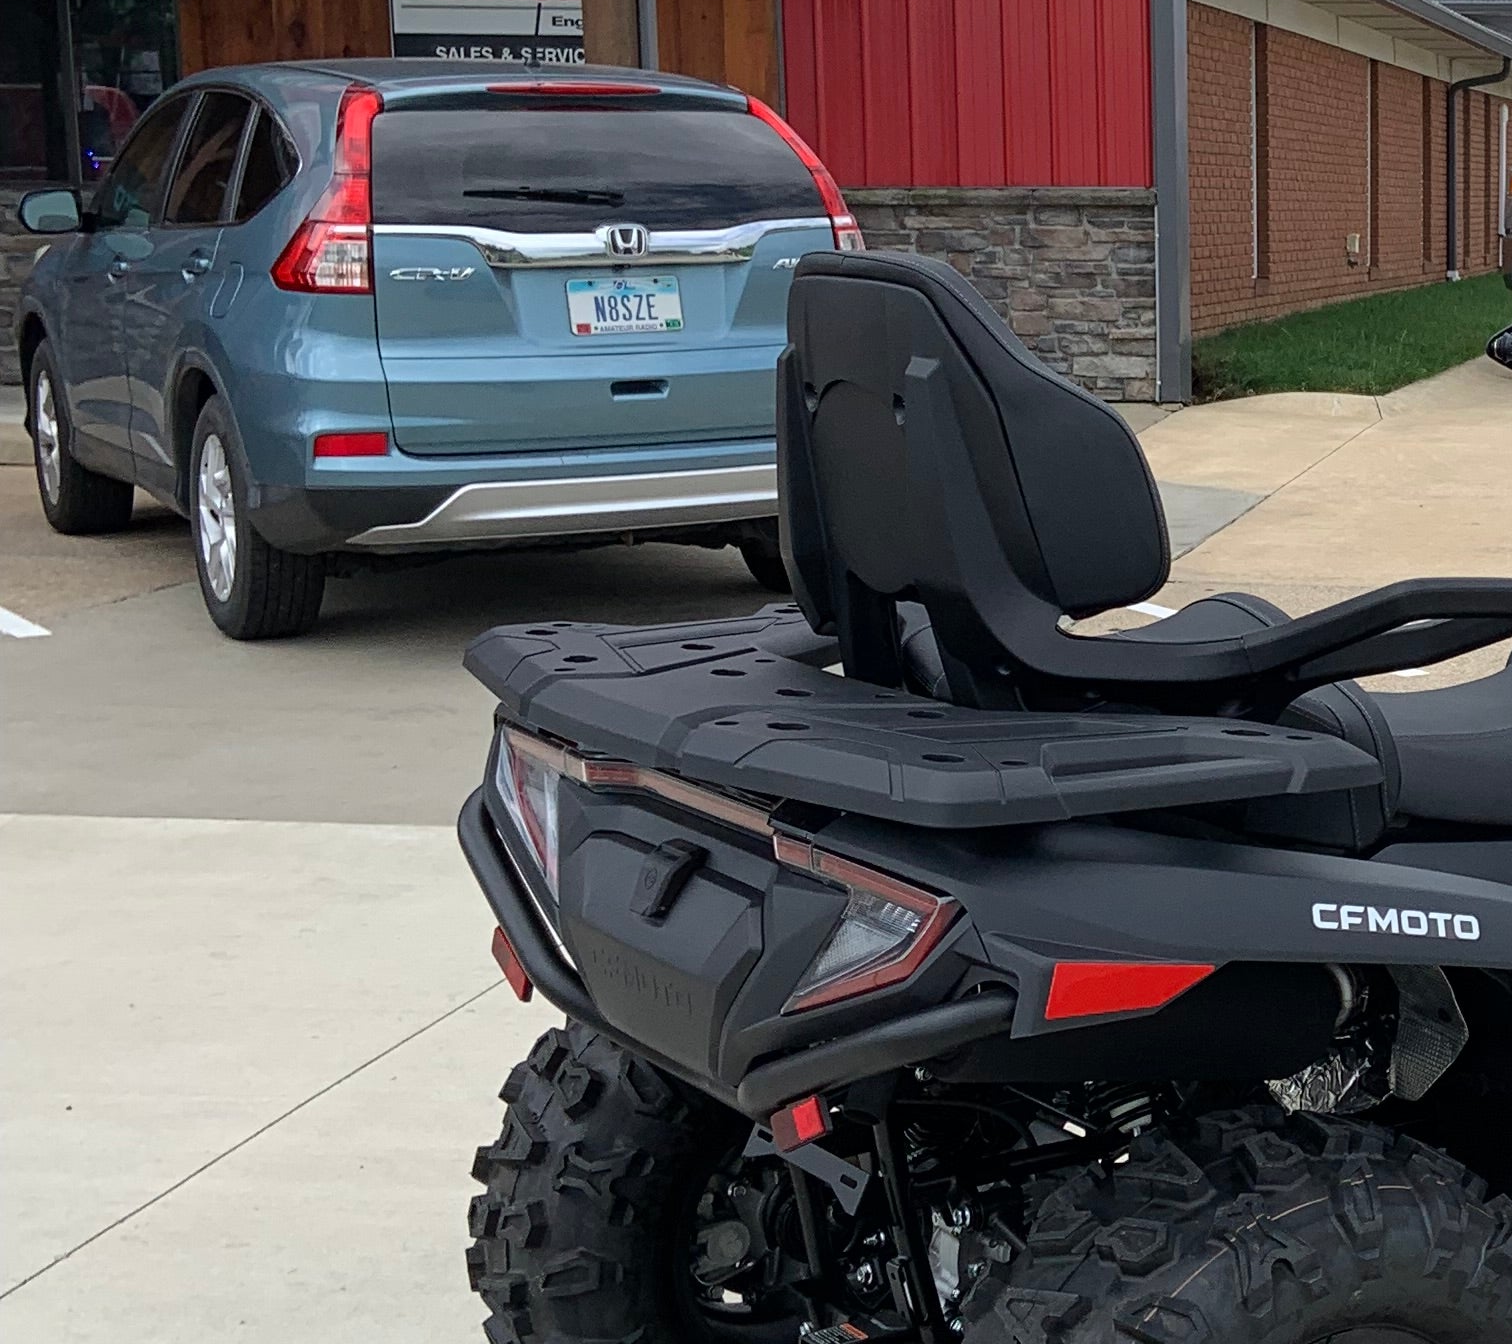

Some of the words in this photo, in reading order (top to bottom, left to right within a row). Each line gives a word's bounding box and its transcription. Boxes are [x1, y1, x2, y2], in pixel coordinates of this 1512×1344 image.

[389, 267, 475, 281] CR-V
[593, 293, 659, 323] N8SZE
[1311, 903, 1481, 941] CFMOTO
